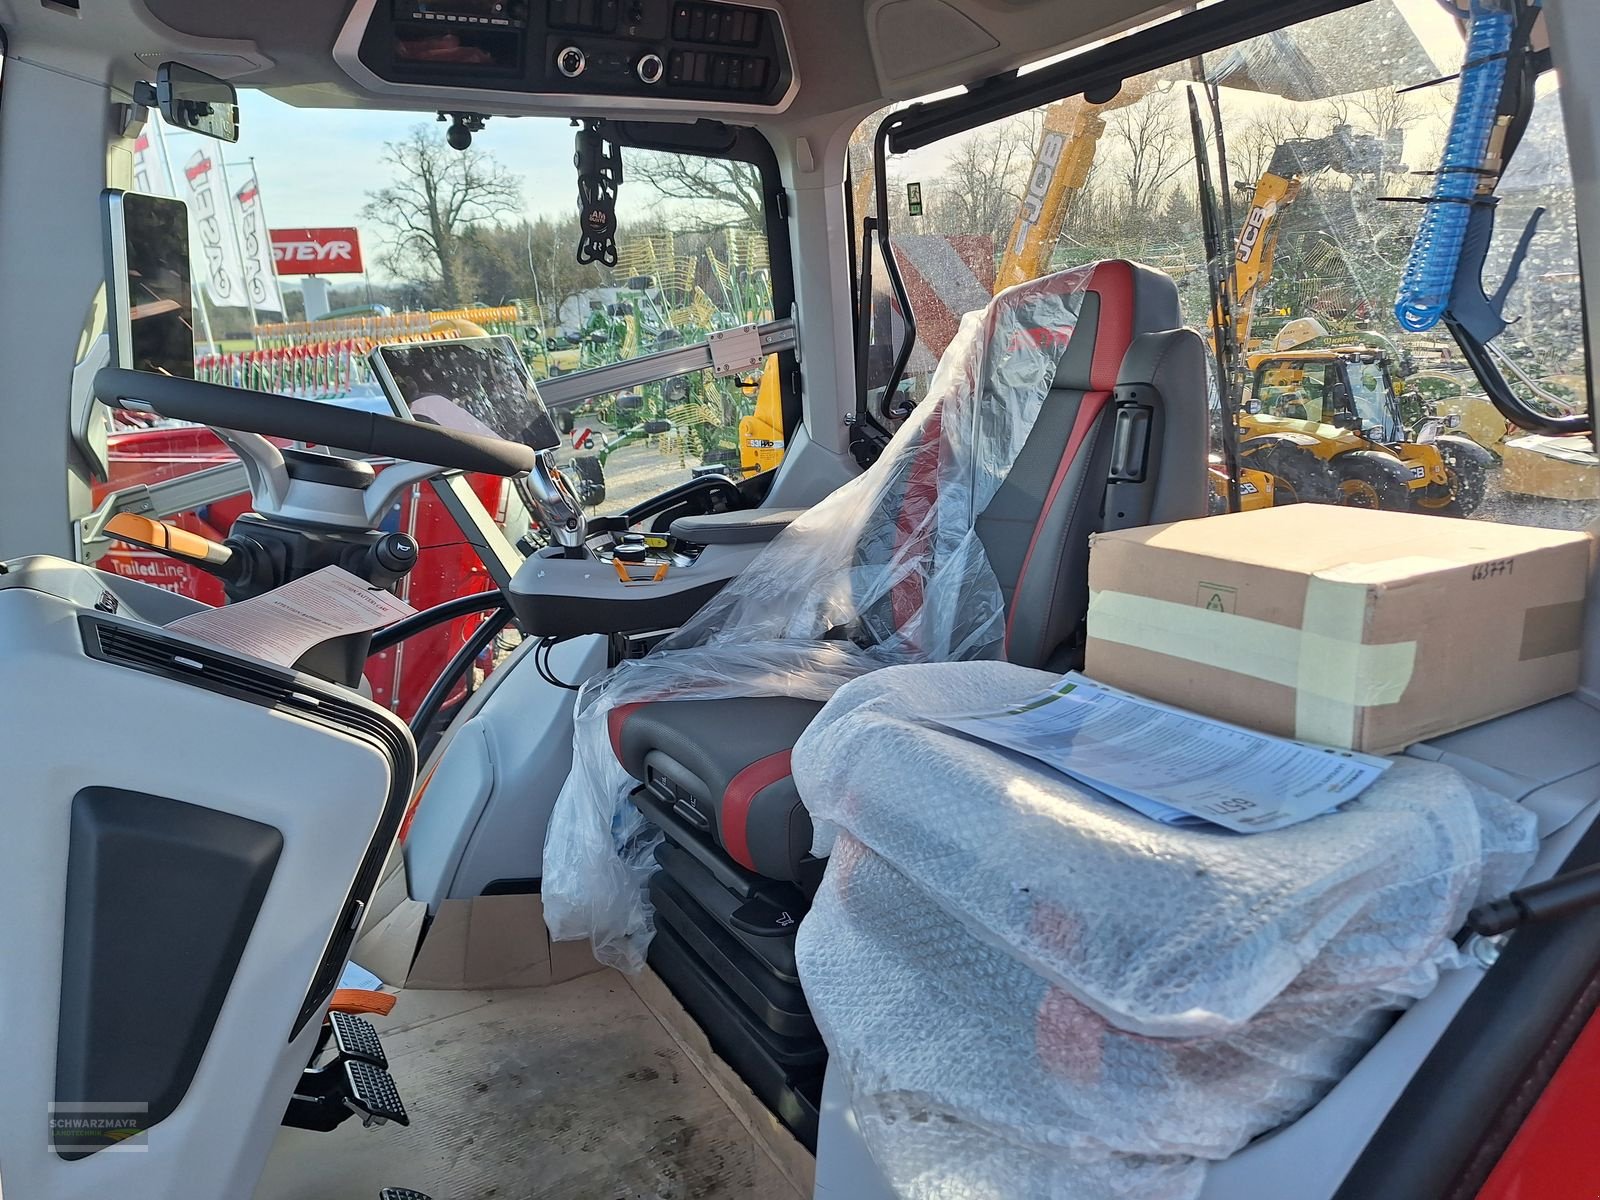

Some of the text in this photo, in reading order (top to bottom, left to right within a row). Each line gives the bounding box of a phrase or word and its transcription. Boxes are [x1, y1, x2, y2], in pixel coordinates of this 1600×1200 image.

[1021, 133, 1063, 223] JCB
[272, 240, 353, 261] STEYR
[1238, 207, 1266, 262] JCB
[110, 559, 185, 577] TrailedLine
